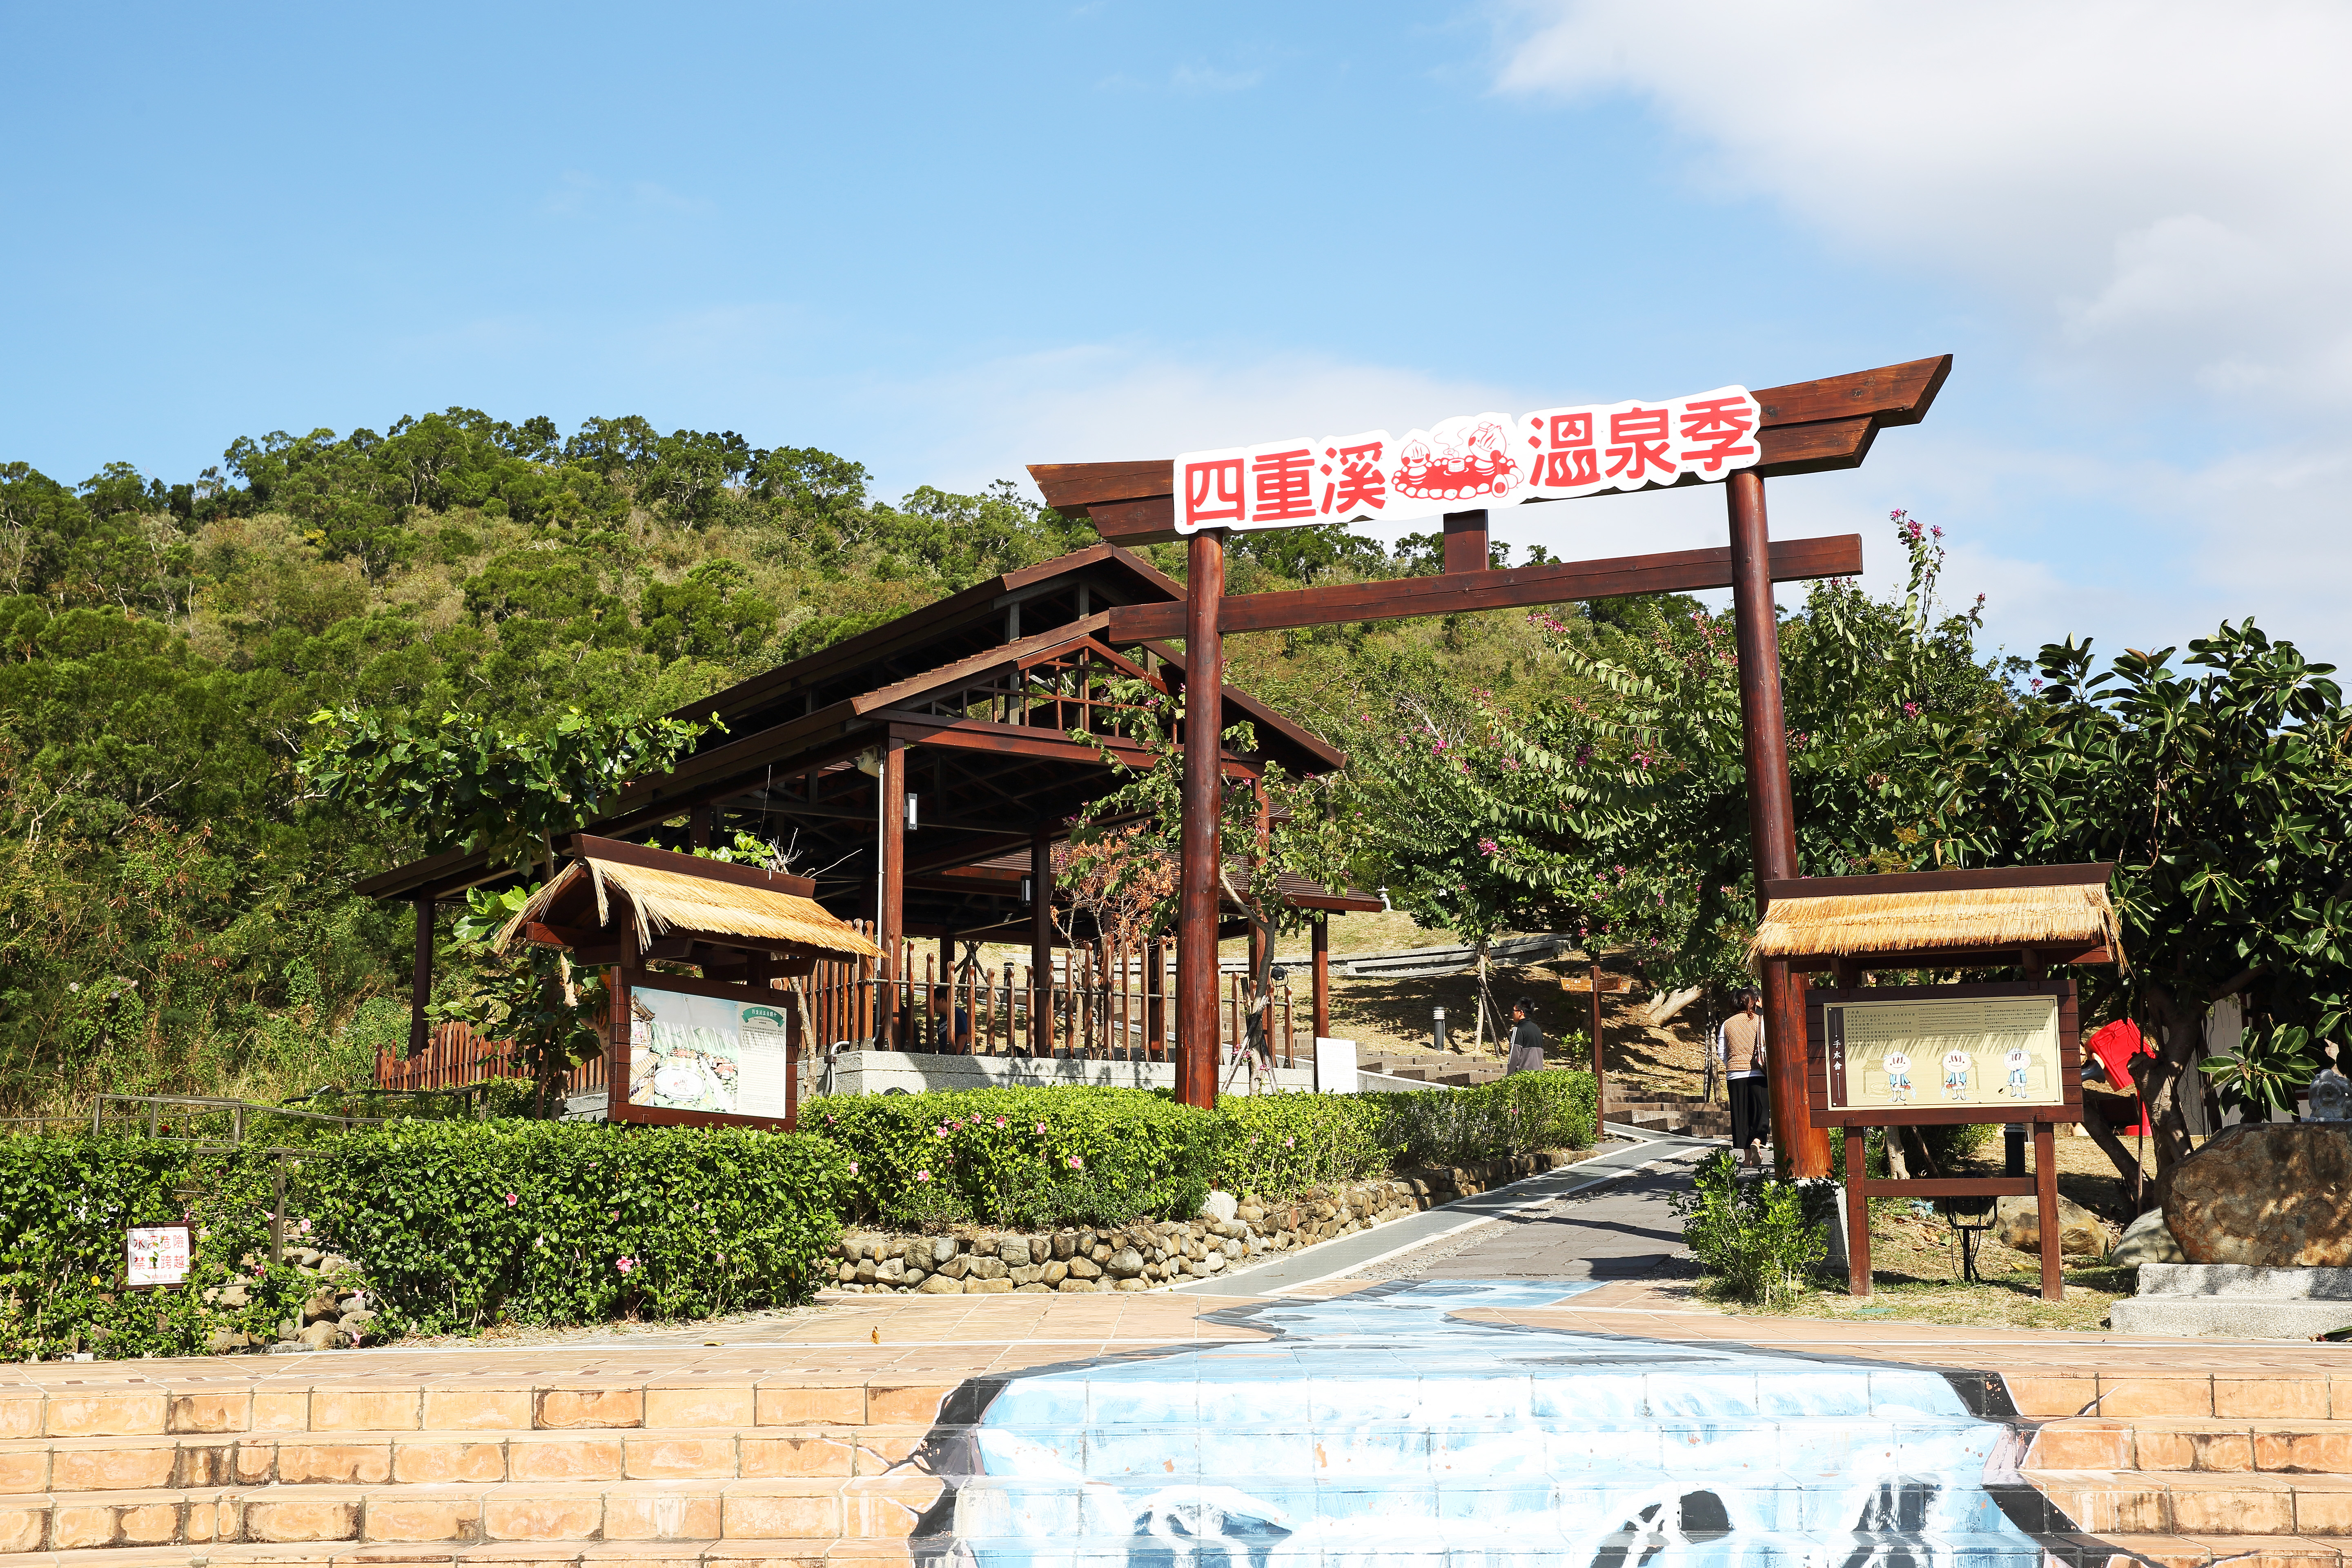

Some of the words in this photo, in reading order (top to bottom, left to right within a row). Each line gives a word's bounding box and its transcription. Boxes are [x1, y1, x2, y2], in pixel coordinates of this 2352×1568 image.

[1185, 441, 1387, 526] 四重溪
[1528, 395, 1755, 487] 溫泉季
[1833, 1040, 1842, 1071] 手水舍
[134, 1234, 185, 1250] 水深危險
